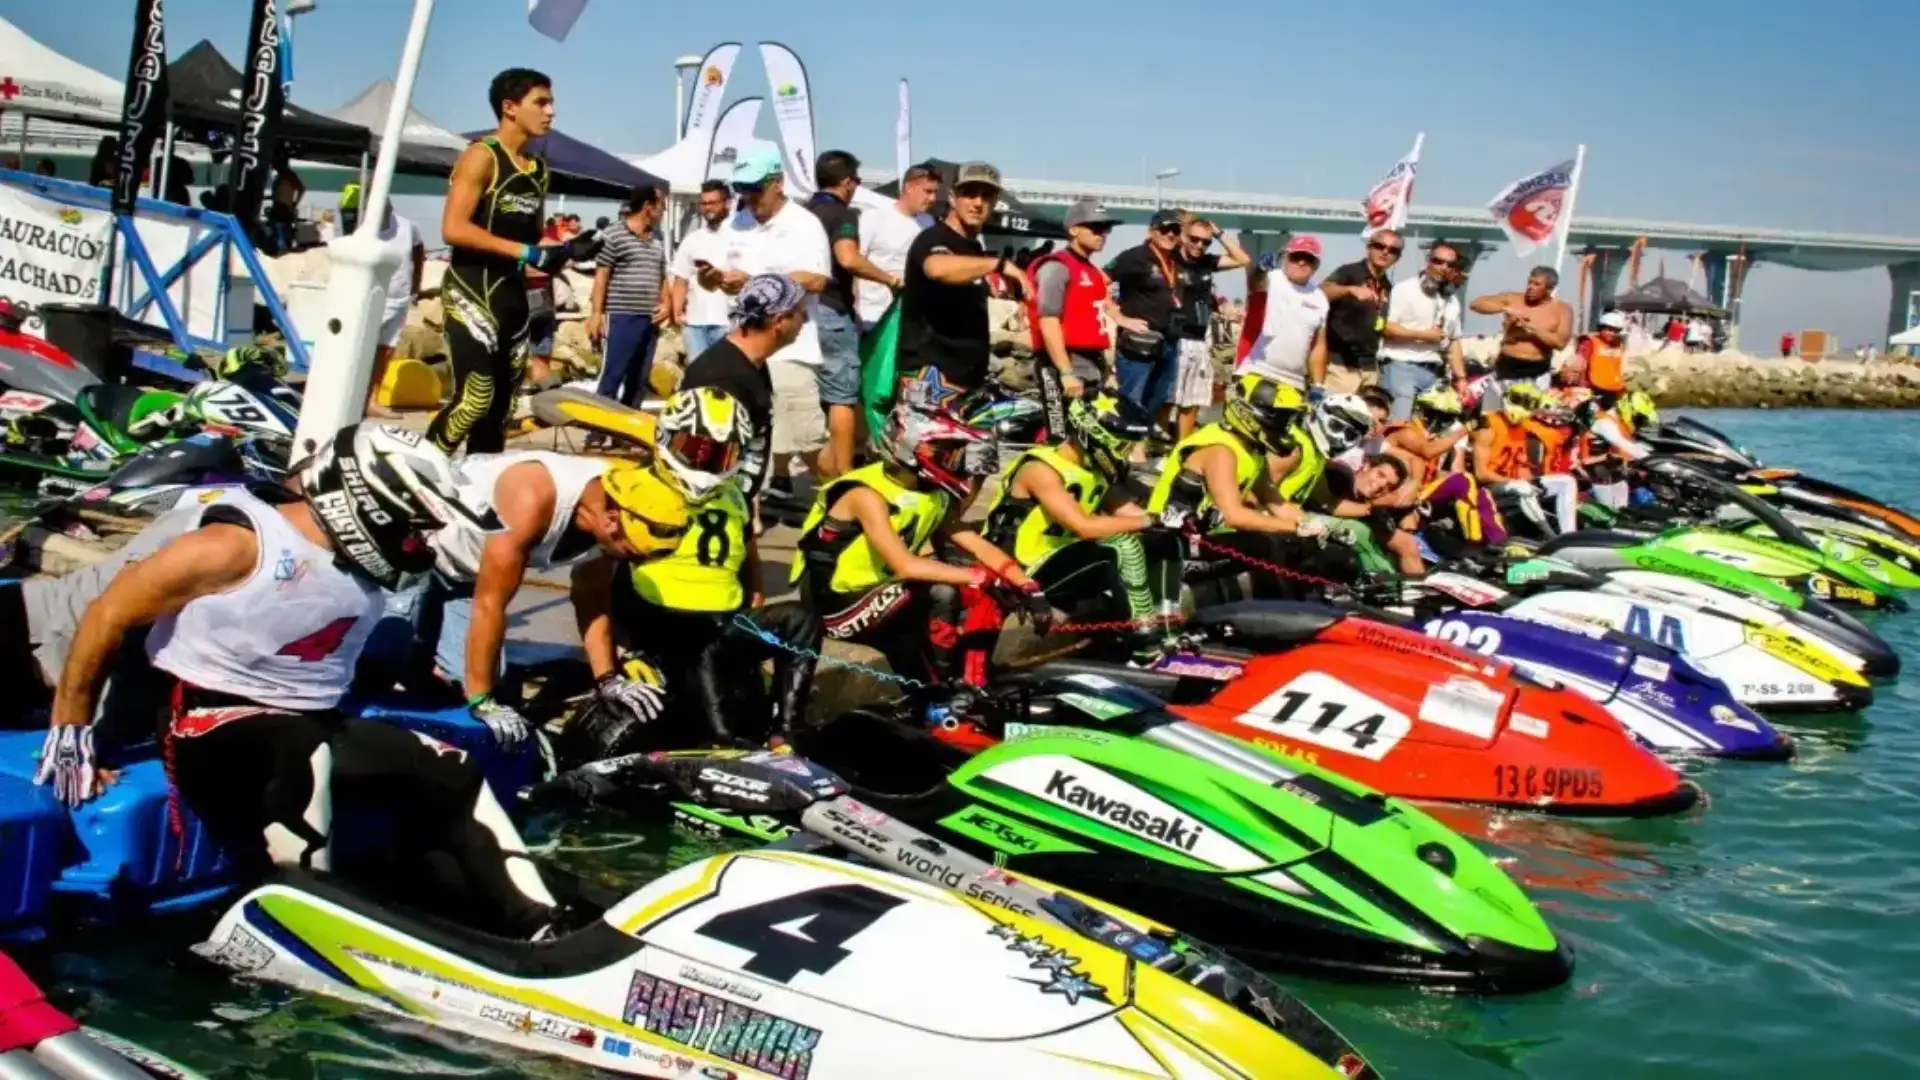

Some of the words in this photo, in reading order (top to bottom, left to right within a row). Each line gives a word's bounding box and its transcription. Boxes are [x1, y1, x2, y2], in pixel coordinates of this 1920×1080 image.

[338, 456, 393, 526] SHIRO
[697, 508, 730, 568] 8
[1270, 690, 1387, 750] 114
[698, 767, 773, 793] STAR
[1252, 736, 1320, 766] SOLAS
[821, 809, 894, 844] STAR
[1043, 769, 1204, 853] Kawasaki
[895, 847, 965, 890] world
[693, 883, 913, 985] 4
